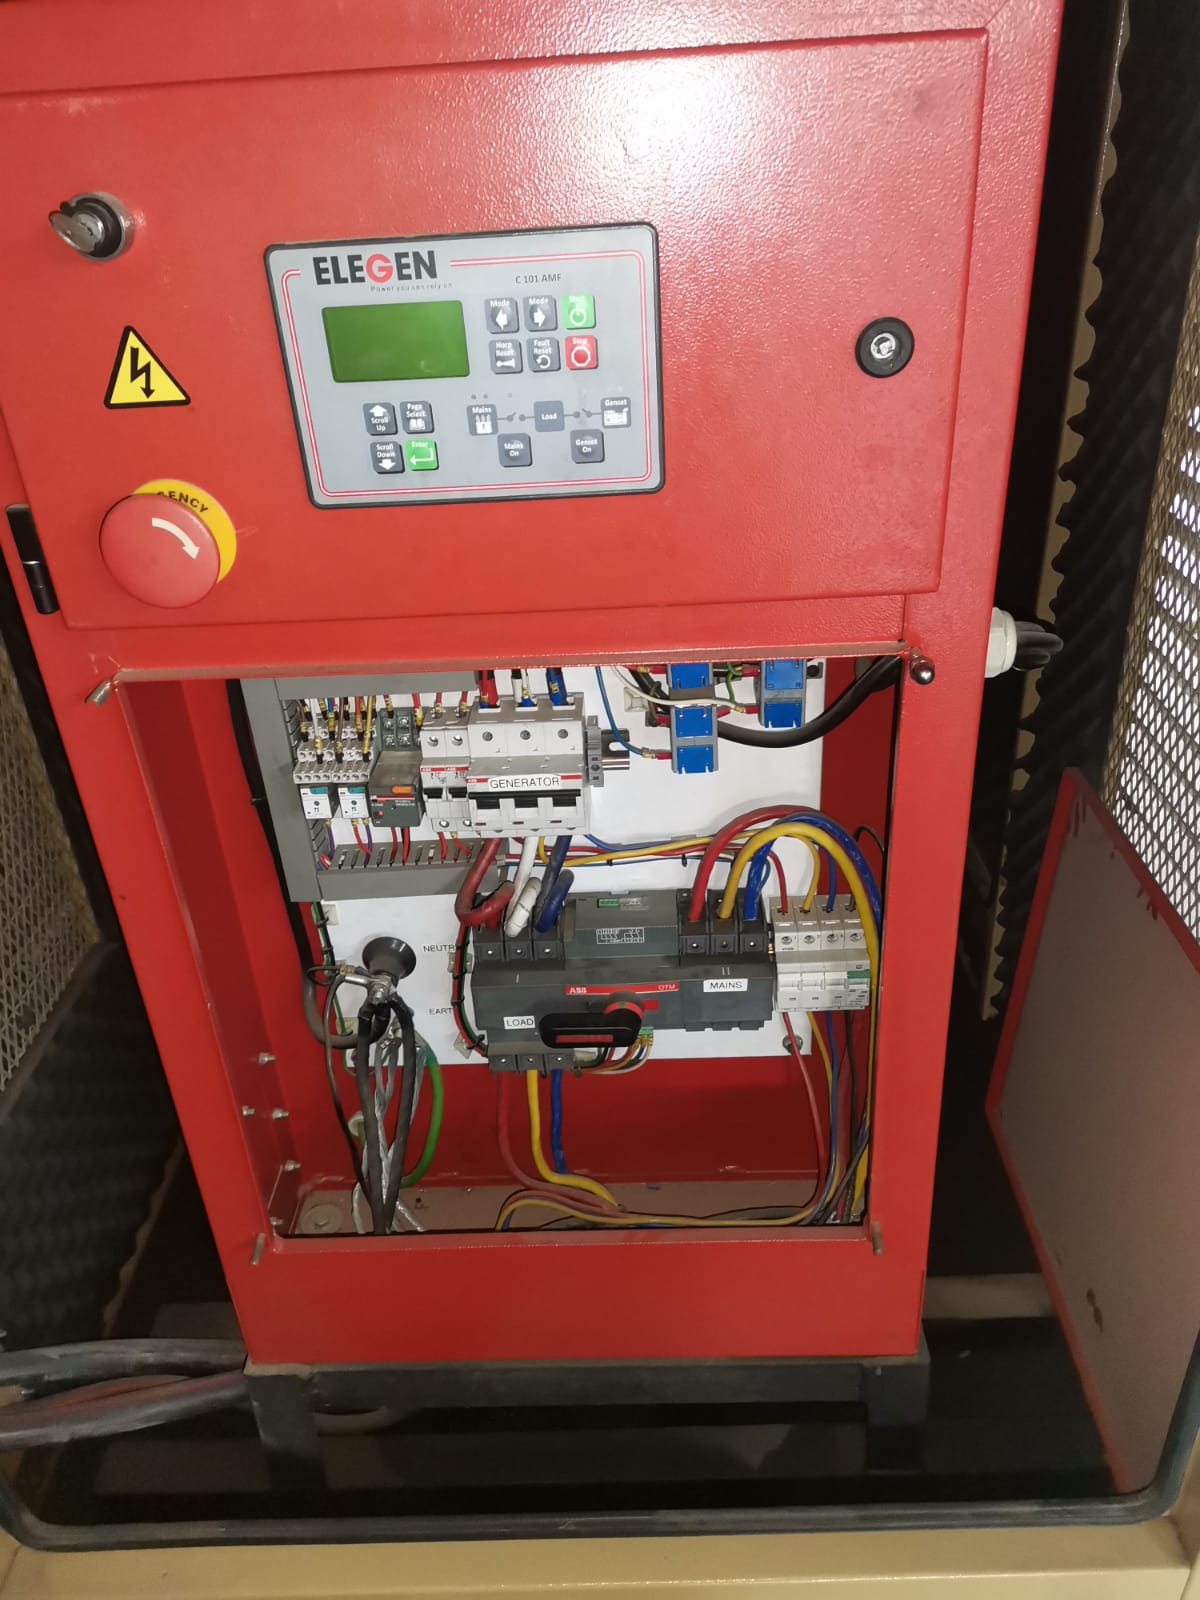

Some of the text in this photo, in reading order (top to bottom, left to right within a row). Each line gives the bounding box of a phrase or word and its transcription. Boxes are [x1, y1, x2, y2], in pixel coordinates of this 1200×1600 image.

[313, 250, 437, 285] ELEGEN
[515, 273, 562, 284] C 101 AMF
[529, 297, 549, 305] Mode
[572, 337, 588, 345] Stop
[407, 403, 423, 411] Page
[472, 406, 492, 414] Mains
[541, 413, 558, 421] Load
[504, 442, 524, 450] Mains
[575, 438, 597, 446] Genset
[489, 776, 560, 789] GENERATOR
[423, 944, 457, 953] NEUTR
[709, 981, 743, 990] MAINS
[429, 1007, 453, 1015] EART
[506, 1018, 534, 1027] LOAD
